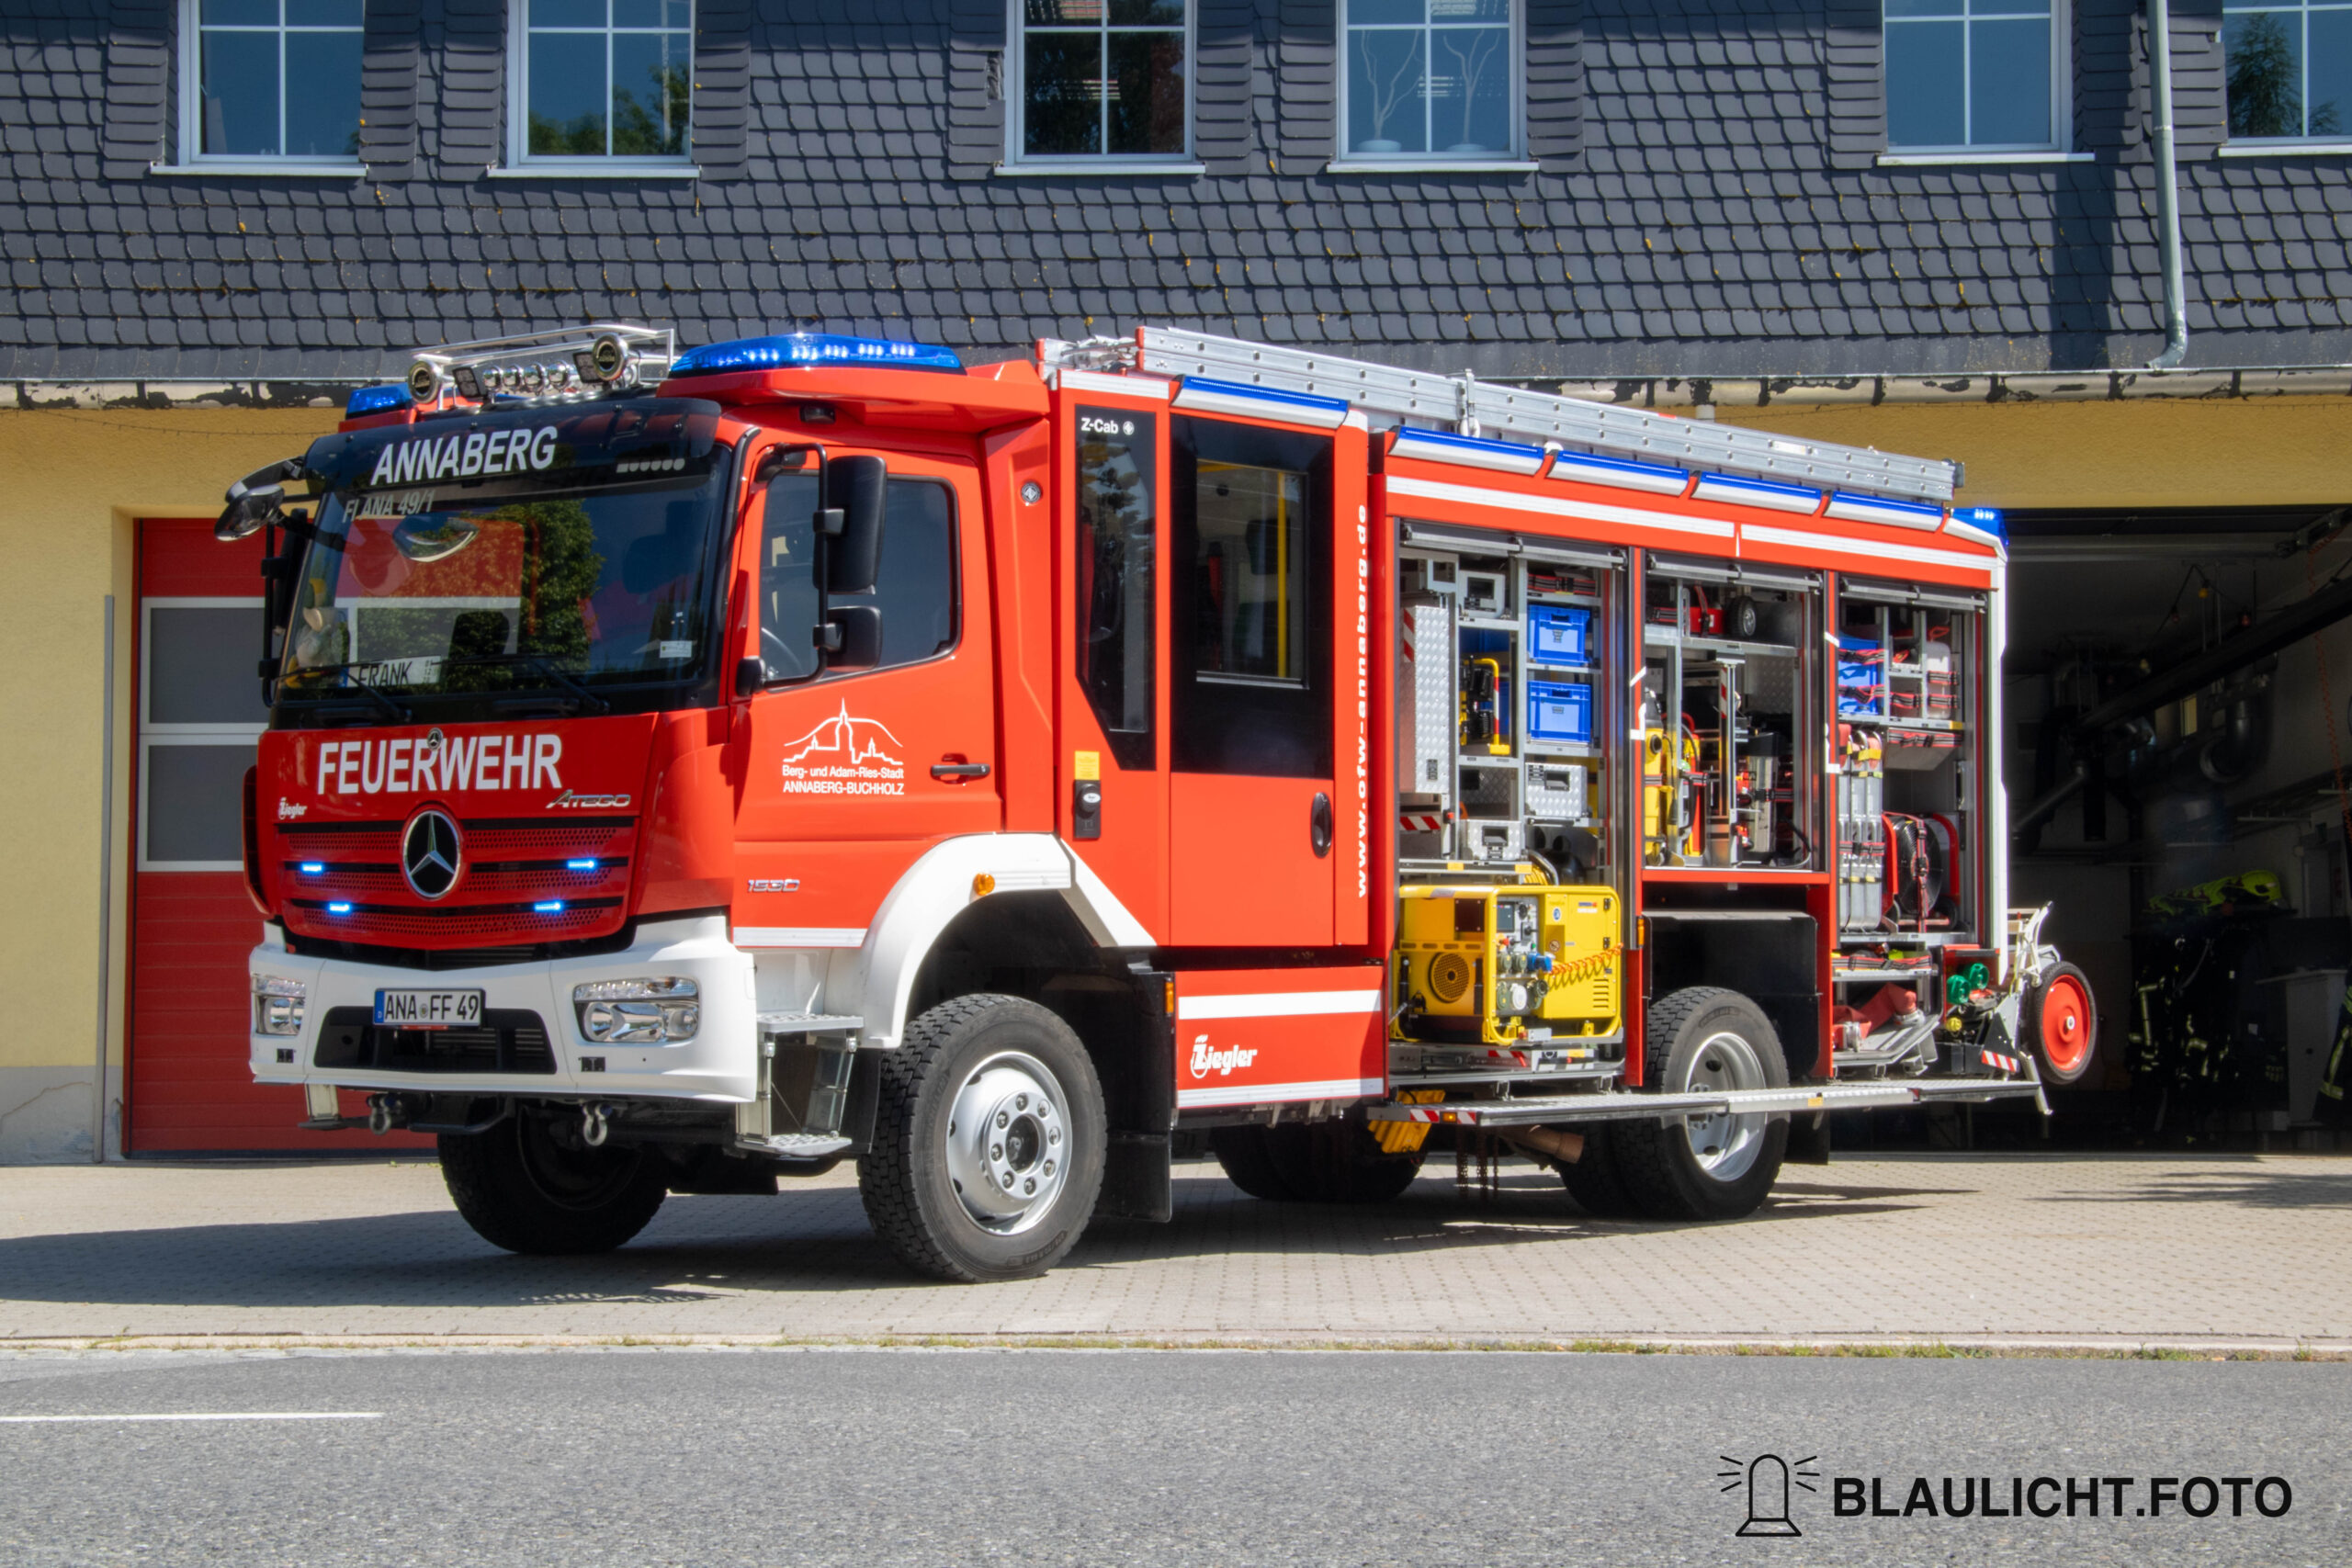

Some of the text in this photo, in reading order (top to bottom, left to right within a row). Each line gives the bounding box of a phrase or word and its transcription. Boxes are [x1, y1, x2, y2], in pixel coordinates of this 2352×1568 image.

[1080, 417, 1119, 434] Z-Cab
[370, 425, 559, 486] ANNABERG
[359, 493, 393, 521] ANA
[398, 489, 435, 514] 49/1
[1356, 504, 1367, 898] www.ofw-annaberg.de
[317, 734, 562, 795] FEUERWEHR
[782, 764, 904, 779] Berg- und Adam-Ries-Stadt
[783, 780, 904, 795] ANNABERG-BUCHHOLZ
[385, 995, 417, 1020] ANA
[429, 995, 453, 1020] FF
[457, 995, 479, 1020] 49
[1190, 1034, 1258, 1078] Ziegler
